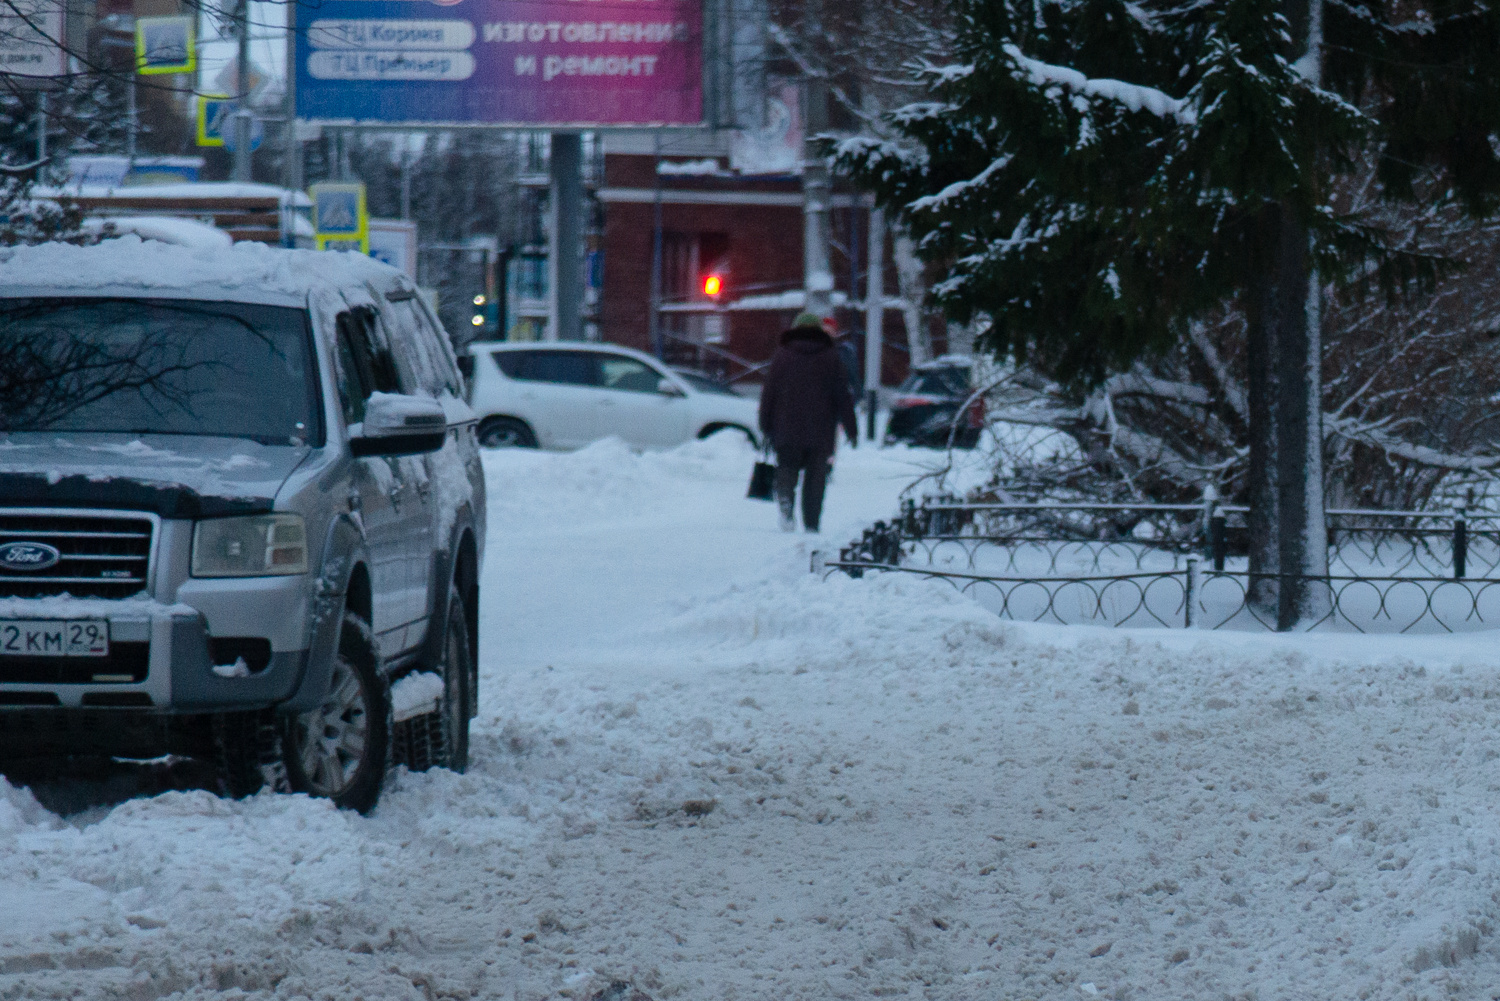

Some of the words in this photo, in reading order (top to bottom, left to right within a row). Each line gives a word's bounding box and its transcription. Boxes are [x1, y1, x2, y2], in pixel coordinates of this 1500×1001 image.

[514, 55, 537, 76] и
[543, 55, 658, 81] ремонт
[6, 547, 43, 562] Ford
[70, 624, 98, 645] 29
